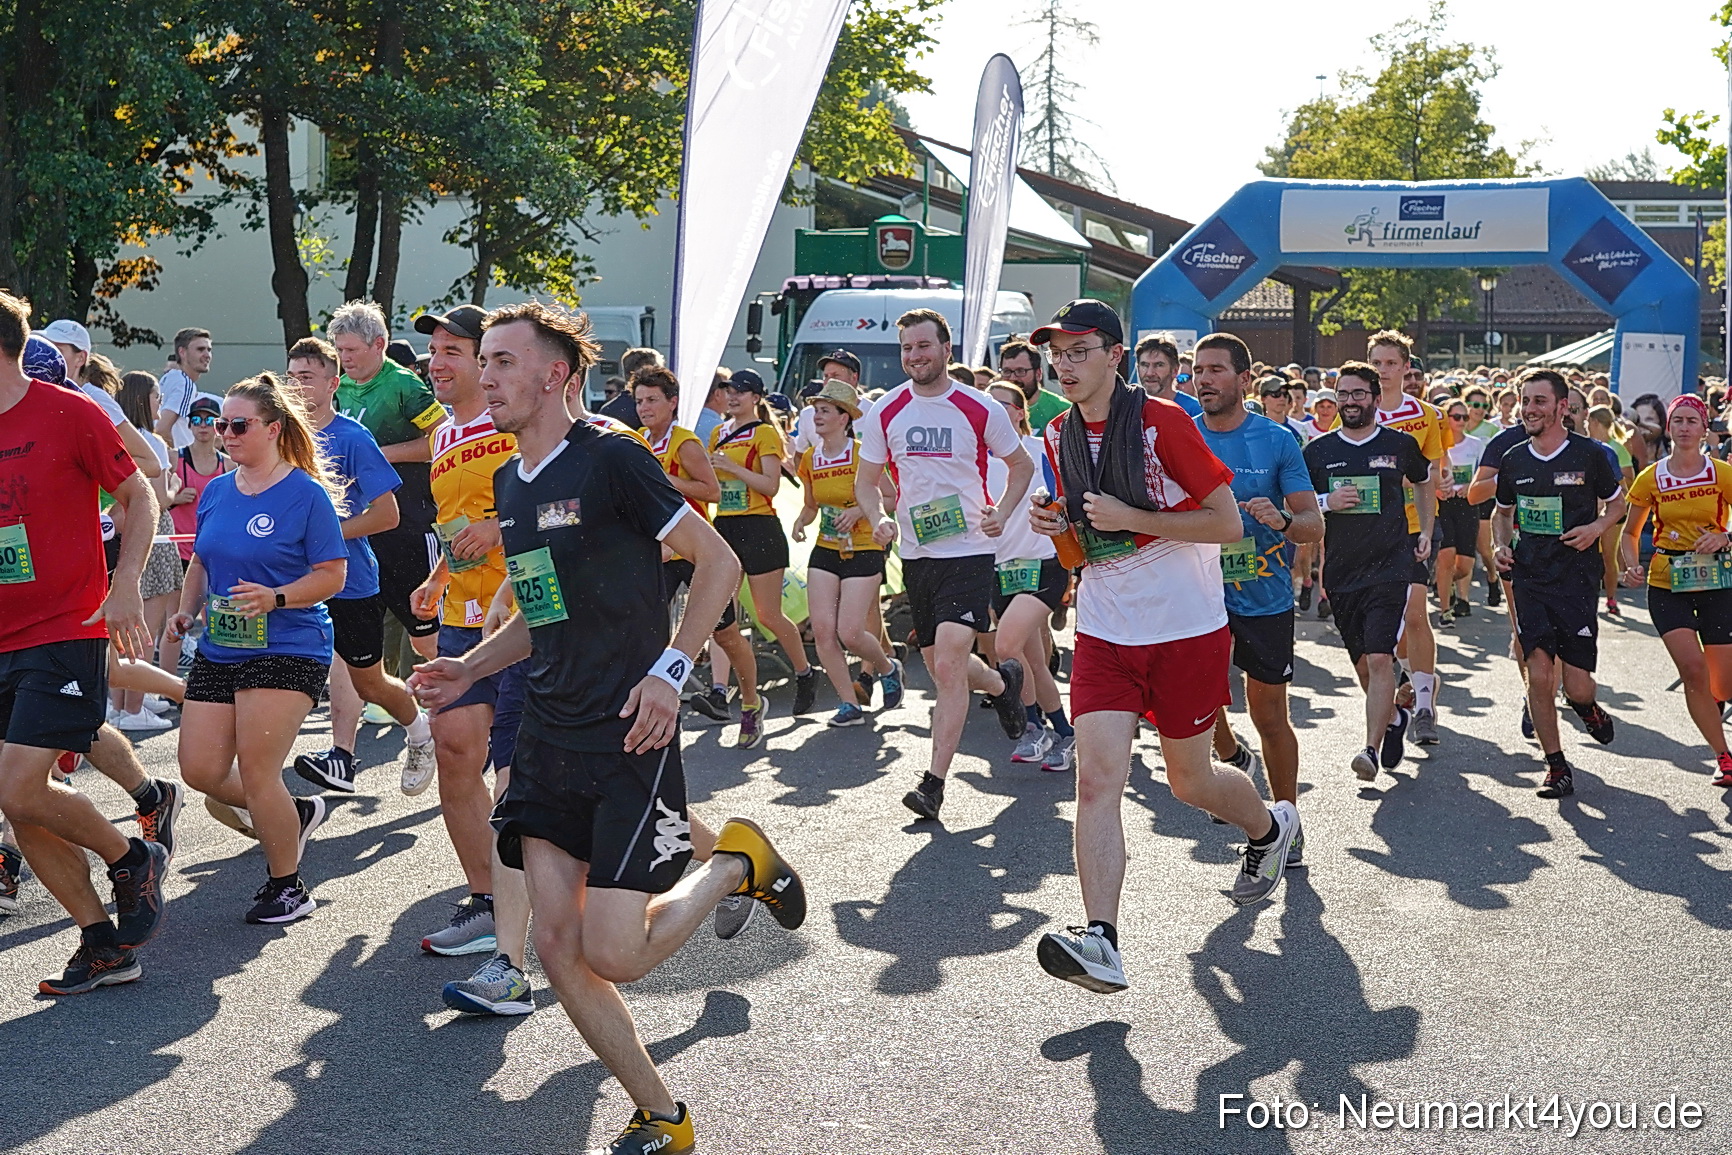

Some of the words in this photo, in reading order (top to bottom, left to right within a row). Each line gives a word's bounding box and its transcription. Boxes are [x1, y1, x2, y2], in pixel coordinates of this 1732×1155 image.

[985, 83, 1011, 188] Fischer
[997, 99, 1015, 185] AUTOMOBILE
[1409, 202, 1442, 213] Fischer
[1383, 220, 1482, 240] firmenlauf
[1191, 251, 1245, 265] Fischer
[1196, 262, 1240, 270] AUTOMOBILE
[809, 318, 854, 329] abavent
[430, 454, 457, 482] MAX
[461, 438, 514, 465] BÖGL
[813, 471, 830, 480] MAX
[831, 467, 855, 478] BÖGL
[1661, 492, 1686, 503] MAX
[1689, 487, 1719, 499] BÖGL
[924, 511, 952, 530] 504
[1526, 509, 1548, 522] 421
[18, 546, 30, 574] 2022
[1247, 553, 1255, 575] 2022
[1007, 568, 1028, 582] 316
[1682, 566, 1708, 579] 816
[516, 576, 544, 604] 425
[548, 576, 562, 611] 2022
[534, 601, 551, 613] Kevin
[218, 613, 248, 632] 431
[60, 687, 83, 697] adidas
[641, 1133, 673, 1155] FILA
